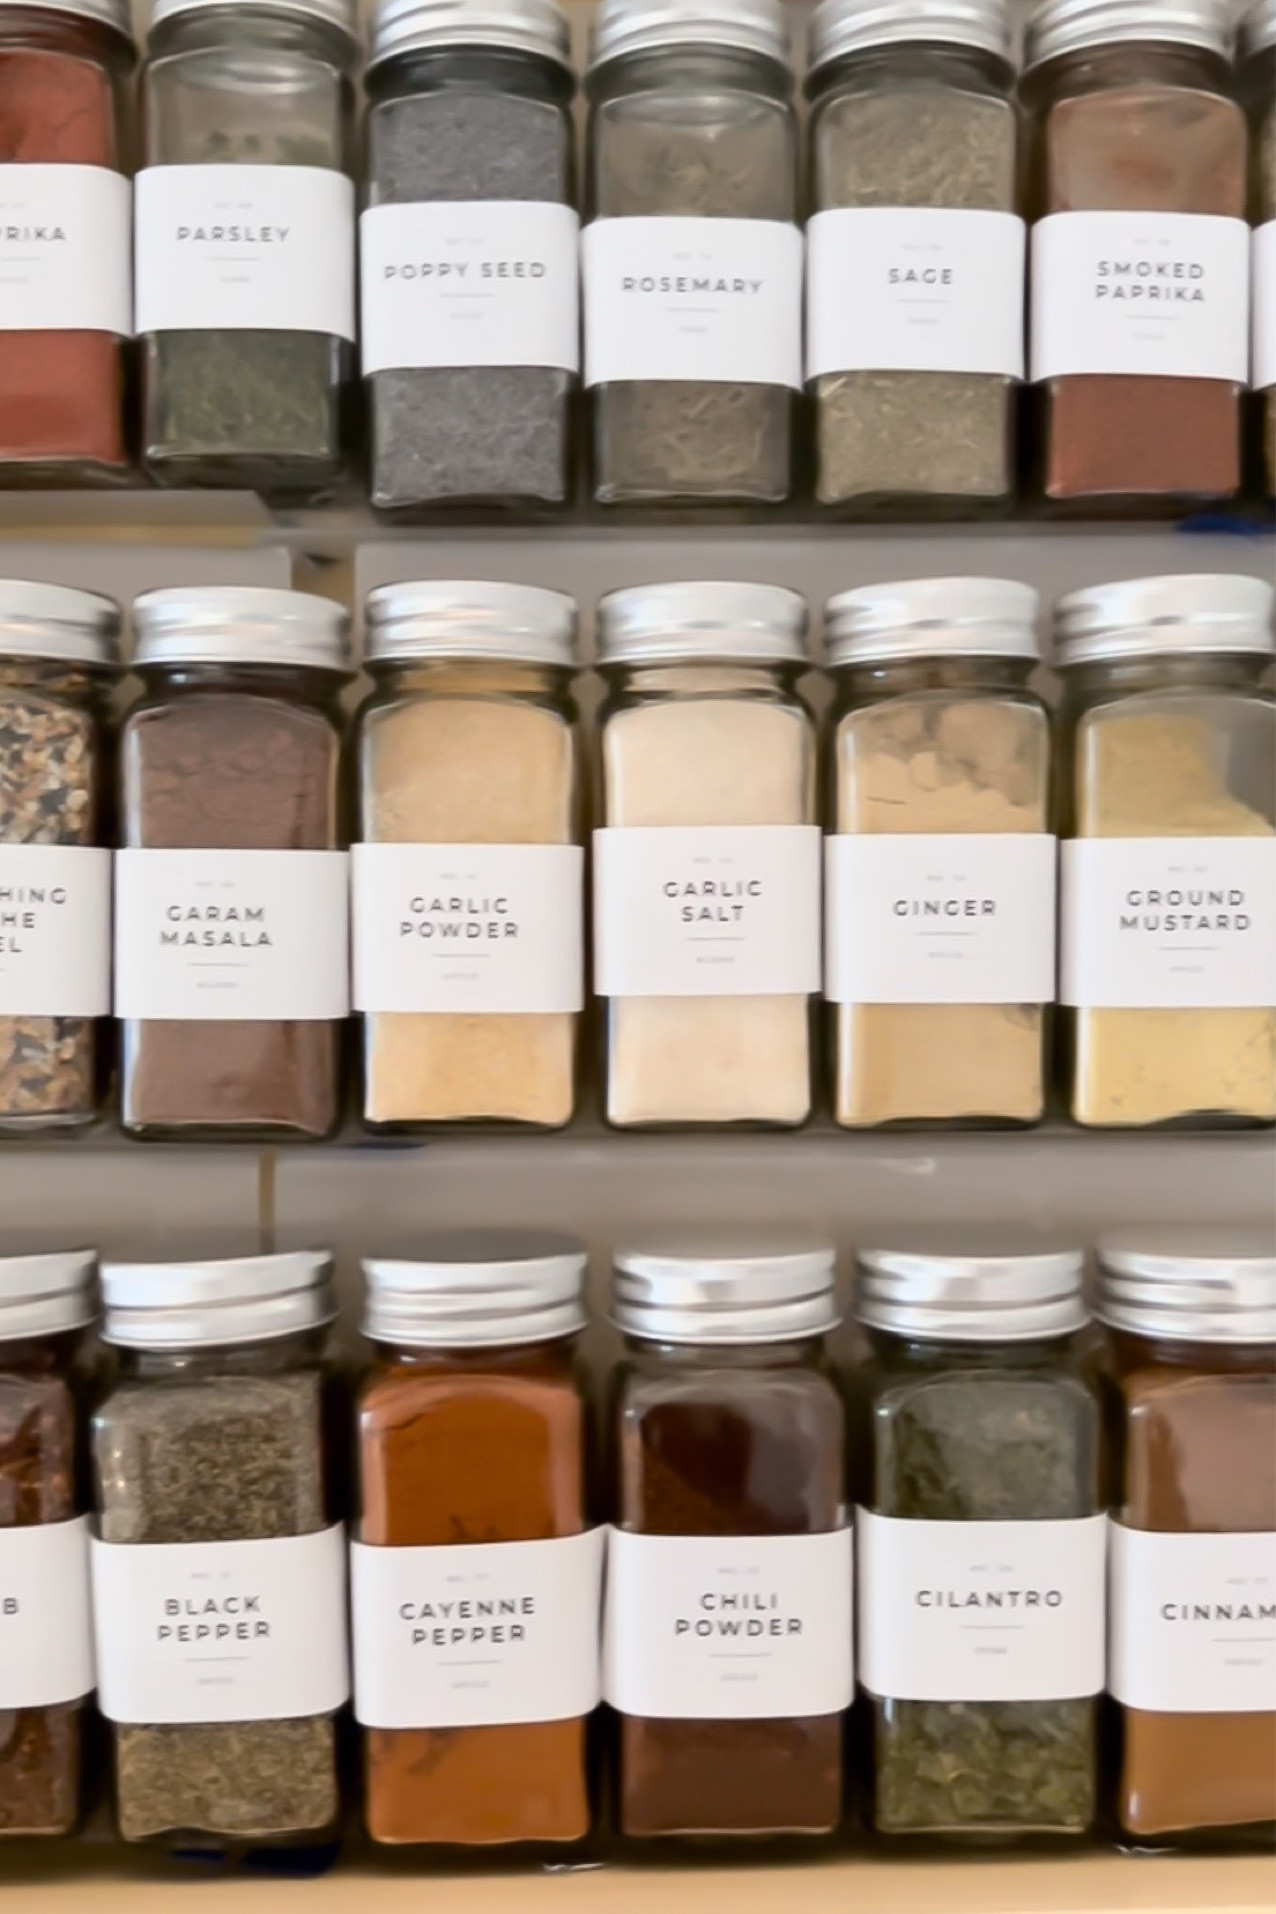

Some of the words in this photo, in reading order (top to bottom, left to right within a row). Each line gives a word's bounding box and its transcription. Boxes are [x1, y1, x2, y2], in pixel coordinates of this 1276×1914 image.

[0, 225, 67, 241] RIKA
[176, 225, 289, 243] PARSLEY
[384, 262, 467, 280] POPPY
[480, 261, 545, 278] SEED
[888, 268, 953, 285] SAGE
[1096, 260, 1204, 280] SMOKED
[622, 276, 761, 293] ROSEMARY
[1094, 284, 1205, 301] PAPRIKA
[662, 879, 763, 899] GARLIC
[1125, 889, 1245, 907] GROUND
[166, 905, 265, 922] GARAM
[409, 896, 509, 915] GARLIC
[680, 904, 746, 923] SALT
[892, 899, 997, 917] GINGER
[399, 921, 519, 939] POWDER
[1119, 914, 1251, 932] MUSTARD
[159, 930, 274, 948] MASALA
[1, 1597, 20, 1616] B
[164, 1595, 261, 1617] BLACK
[398, 1596, 536, 1621] CAYENNE
[699, 1592, 778, 1612] CHILI
[915, 1589, 1063, 1609] CILANTRO
[156, 1620, 271, 1643] PEPPER
[411, 1624, 526, 1647] PEPPER
[674, 1617, 804, 1637] POWDER
